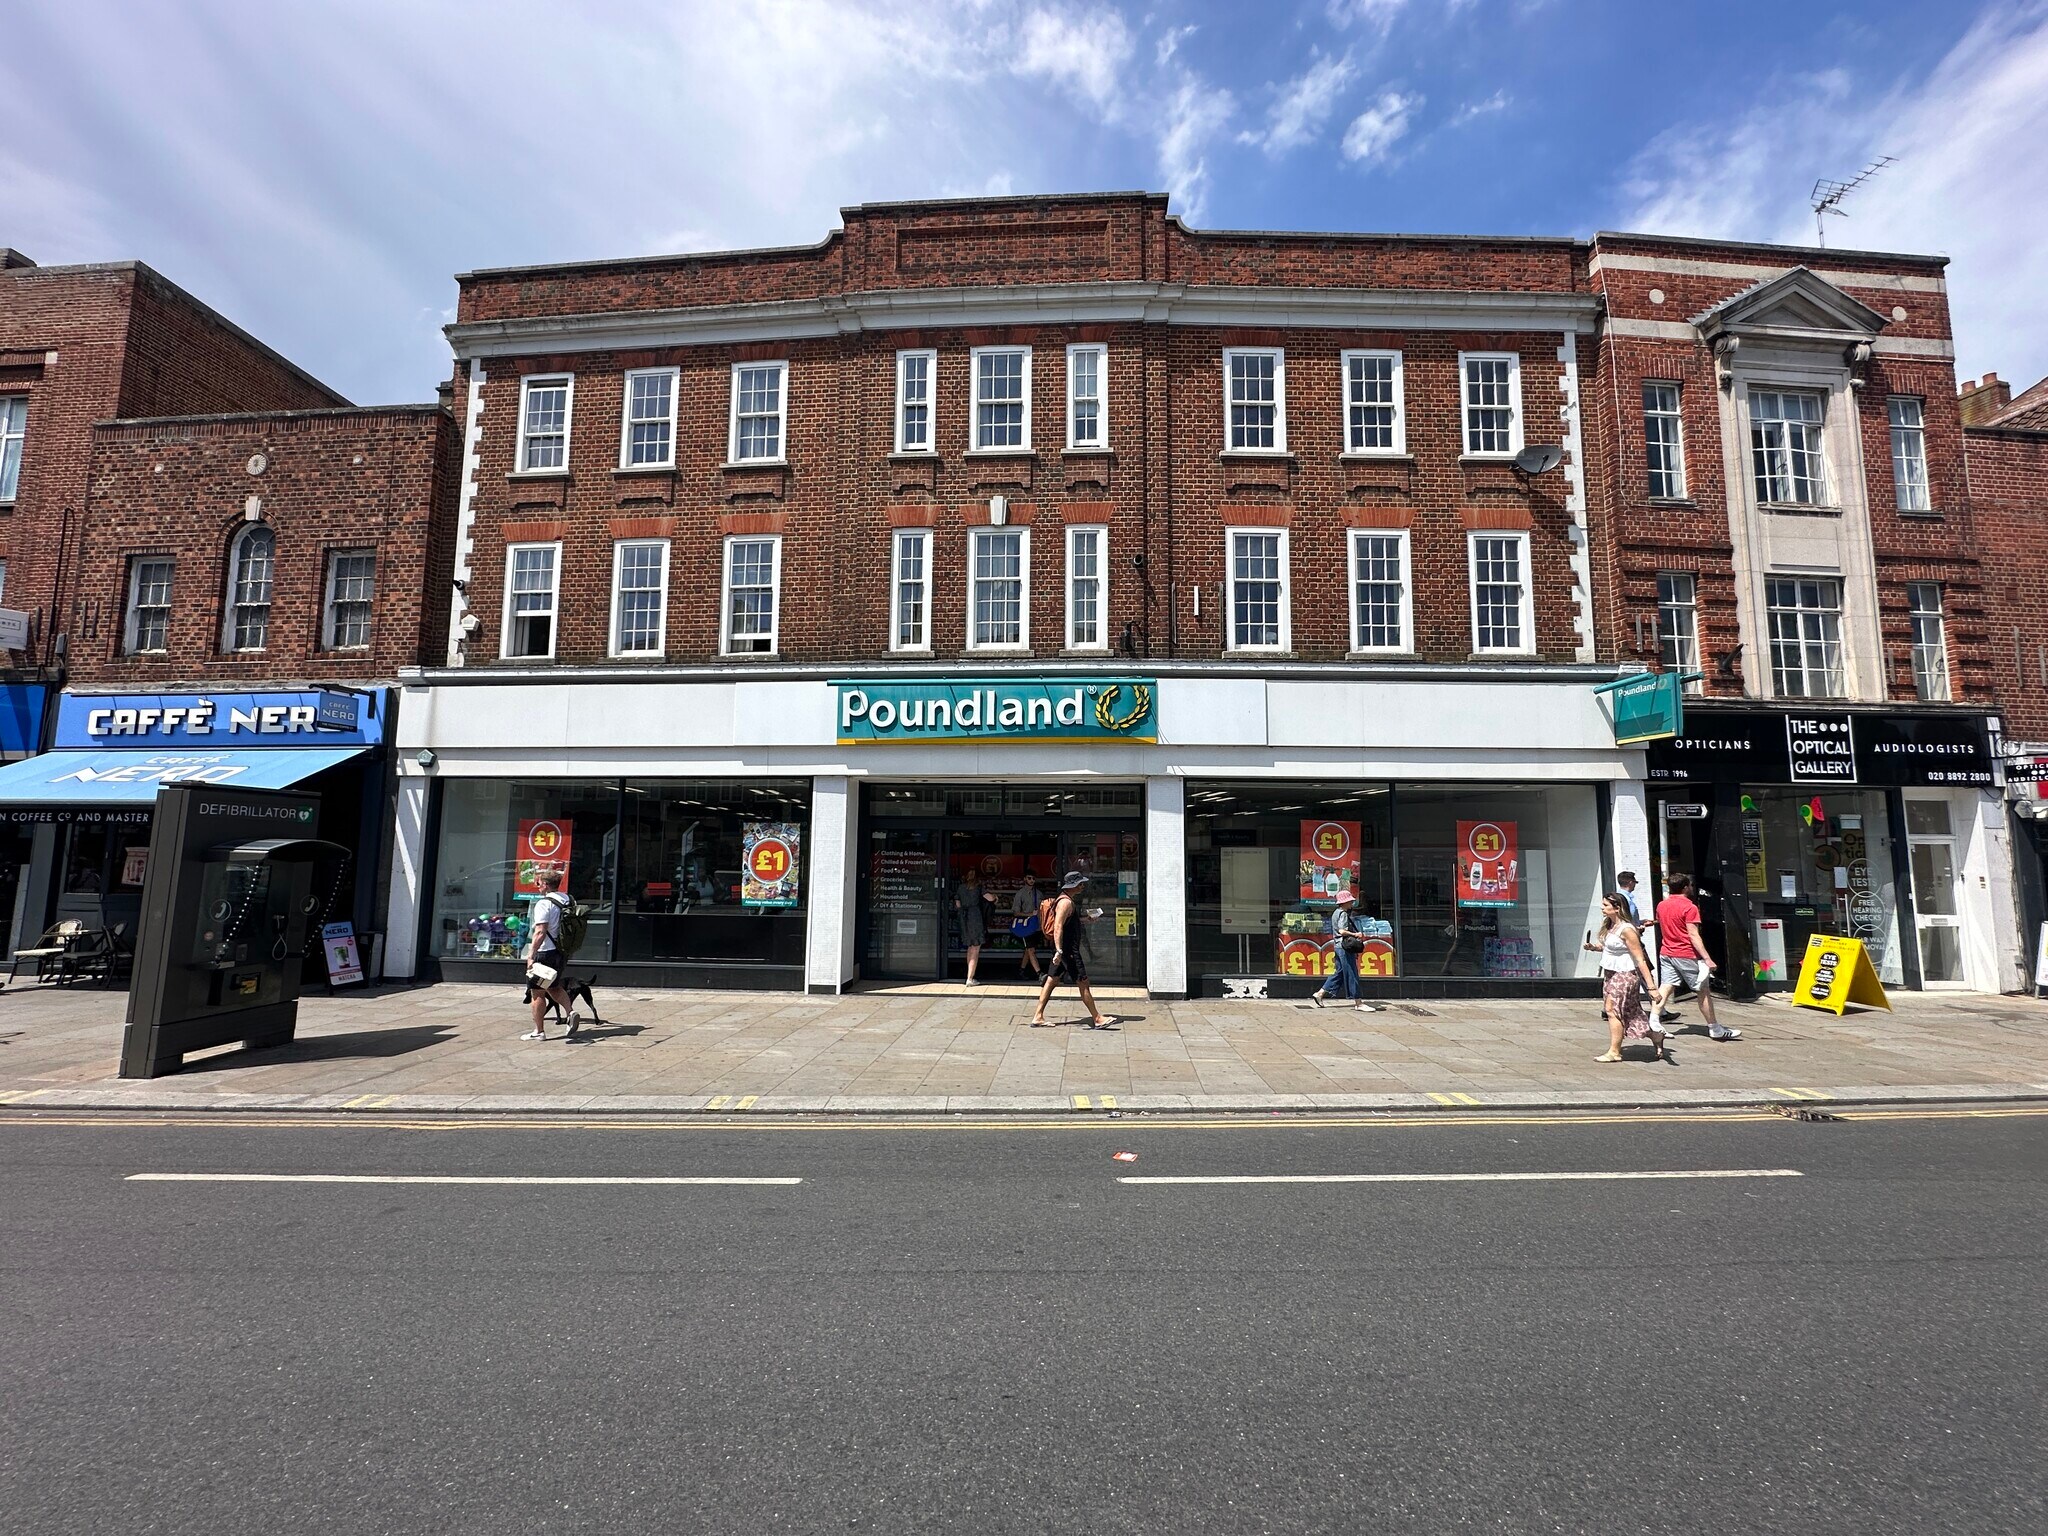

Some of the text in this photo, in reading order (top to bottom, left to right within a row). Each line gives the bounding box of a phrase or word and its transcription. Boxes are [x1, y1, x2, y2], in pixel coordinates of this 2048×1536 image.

[1618, 682, 1656, 697] Poundland
[322, 708, 355, 720] NERO
[842, 689, 1083, 727] Poundland
[88, 698, 341, 735] CAFFÈ NER
[1790, 720, 1818, 734] THE
[1675, 739, 1751, 750] OPTICIANS
[1792, 740, 1850, 754] OPTICAL
[1874, 743, 1974, 754] AUDIOLOGISTS
[48, 766, 250, 782] NERO
[1672, 770, 1688, 778] 1996
[1795, 761, 1851, 774] GALLERY
[1928, 772, 1991, 781] 020 8892 2800
[12, 812, 52, 821] COFFEE
[77, 813, 101, 821] AND
[106, 813, 149, 822] MASTER
[199, 803, 296, 819] DEFIBRILLATOR
[1743, 822, 1757, 831] EE
[534, 830, 555, 846] £1
[1319, 832, 1342, 849] £1
[1476, 833, 1499, 850] £1
[755, 850, 784, 871] £1
[1855, 867, 1873, 876] EYE
[1852, 878, 1878, 887] TESTS
[325, 927, 349, 935] NERO
[1865, 943, 1886, 951] MOVAL
[1287, 952, 1320, 974] £1
[1360, 952, 1393, 974] £1
